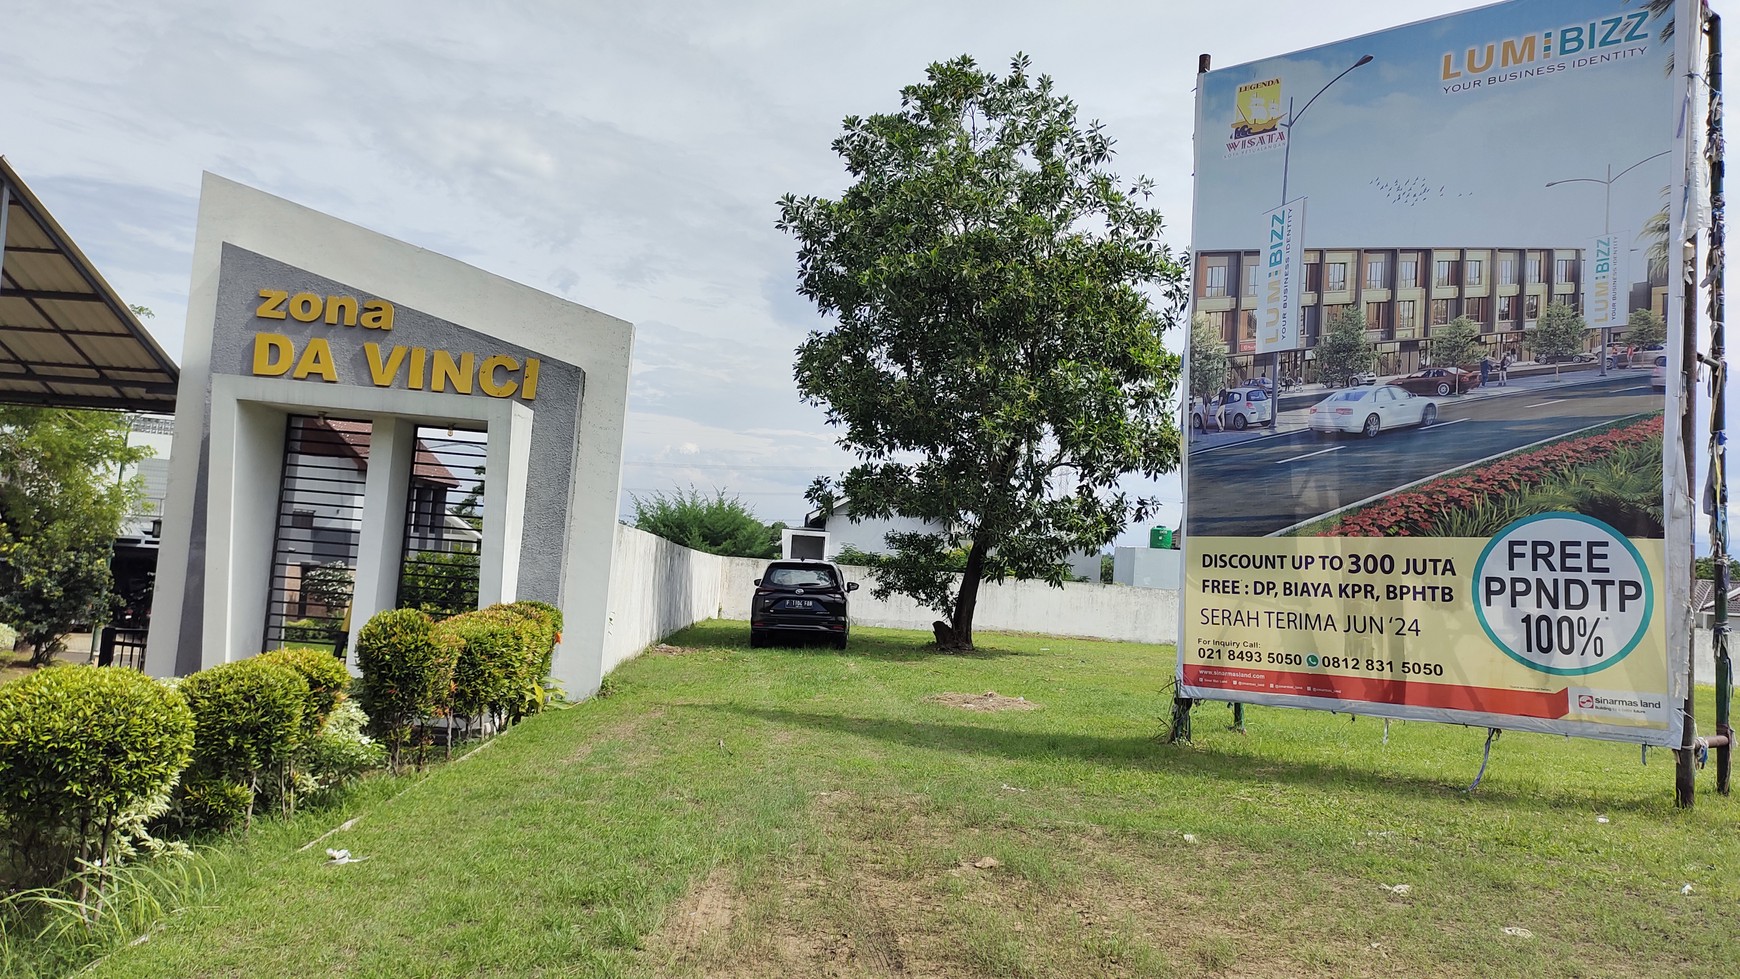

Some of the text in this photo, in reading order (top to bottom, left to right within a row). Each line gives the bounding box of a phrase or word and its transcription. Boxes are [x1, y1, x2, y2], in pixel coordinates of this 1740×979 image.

[1443, 46, 1648, 94] YOUR BUSINESS IDENTITY
[1239, 79, 1279, 93] LEGENDA
[1226, 131, 1286, 152] WISATA
[1285, 208, 1293, 254] IDENTITY
[1282, 256, 1290, 309] BUSINESS
[256, 289, 394, 331] zona
[253, 332, 541, 400] DA VINCI
[1202, 553, 1288, 570] DISCOUNT
[1291, 555, 1315, 570] UP
[1319, 555, 1343, 571] TO
[1347, 553, 1395, 575] 300
[1508, 540, 1610, 574] FREE
[1253, 580, 1278, 598] DP,
[1283, 581, 1333, 598] BIAYA
[1338, 583, 1380, 602] KPR,
[1386, 584, 1454, 602] BPHTB
[1485, 576, 1643, 613] PPNDTP
[1200, 608, 1421, 636] SERAH TERIMA JUN '24
[1197, 638, 1261, 649] For Inquiry Call:
[1198, 648, 1443, 676] 021 8493 5050 0812 831 5050
[1199, 669, 1265, 679] www.sinarmasland.com
[1594, 696, 1661, 709] sinarmas land
